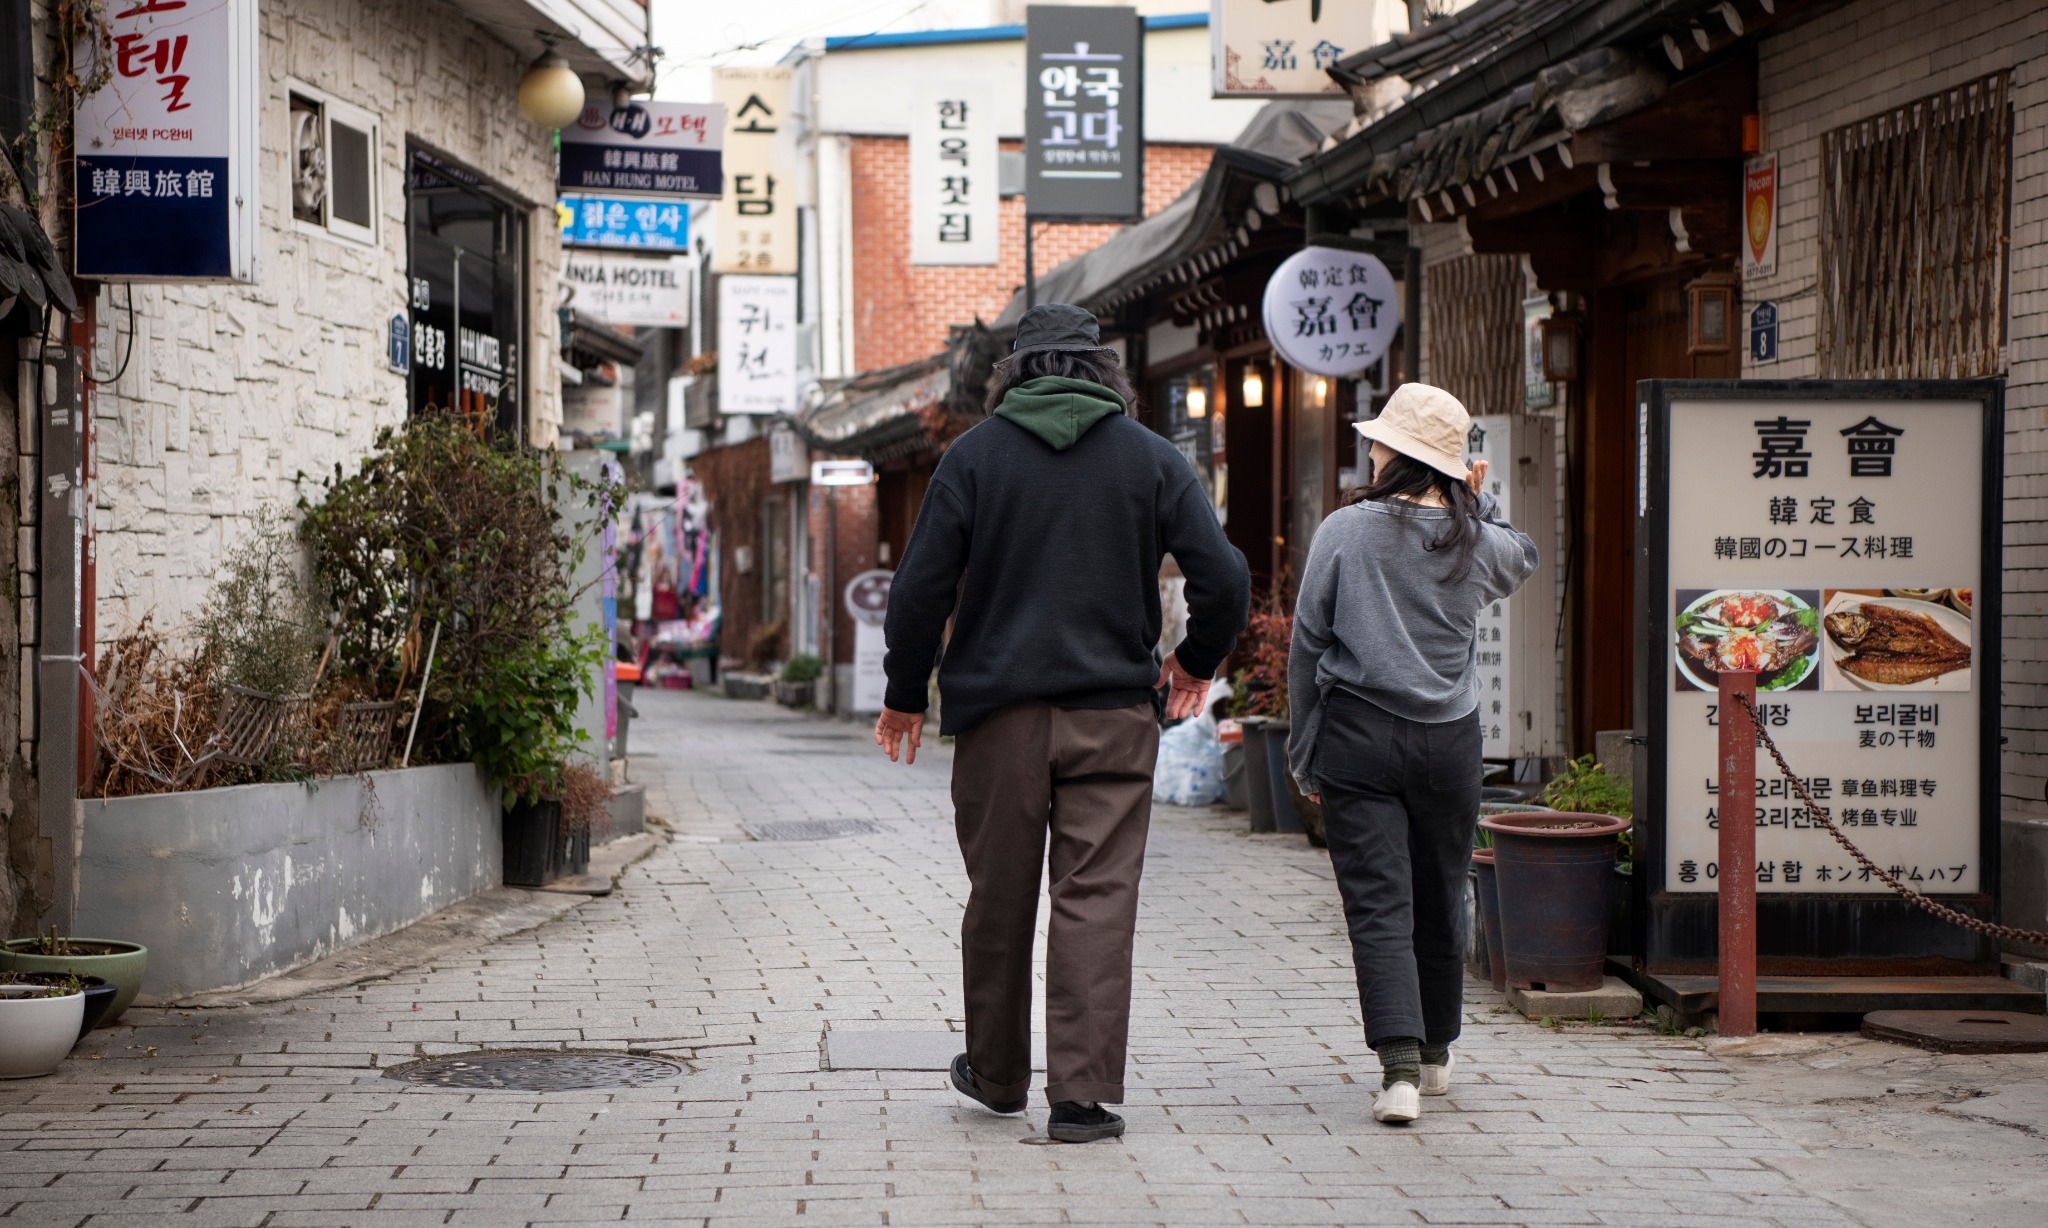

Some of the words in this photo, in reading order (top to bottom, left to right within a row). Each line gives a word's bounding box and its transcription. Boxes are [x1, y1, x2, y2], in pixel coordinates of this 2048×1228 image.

[1039, 65, 1123, 107] 안국
[112, 128, 148, 141] 인터넷
[152, 128, 193, 141] PC완비
[653, 114, 708, 143] 모텔
[1040, 108, 1123, 149] 고다
[733, 93, 777, 215] 소담
[92, 168, 214, 198] 韓興旅館
[583, 170, 611, 186] HAN
[614, 172, 651, 188] HUNG
[655, 174, 699, 190] MOTEL
[938, 100, 971, 242] 한옥찻집
[613, 267, 678, 288] HOSTEL
[1290, 291, 1385, 337] 嘉會
[1760, 331, 1768, 356] 8
[1752, 416, 1905, 478] 嘉會
[1769, 496, 1876, 525] 韓定食
[1714, 535, 1914, 559] 韓國のコース料理
[1854, 703, 1940, 726] 보리굴비
[1859, 729, 1936, 748] 麦の干物
[1841, 778, 1938, 798] 章鱼料理专
[1841, 808, 1918, 827] 烤鱼专业
